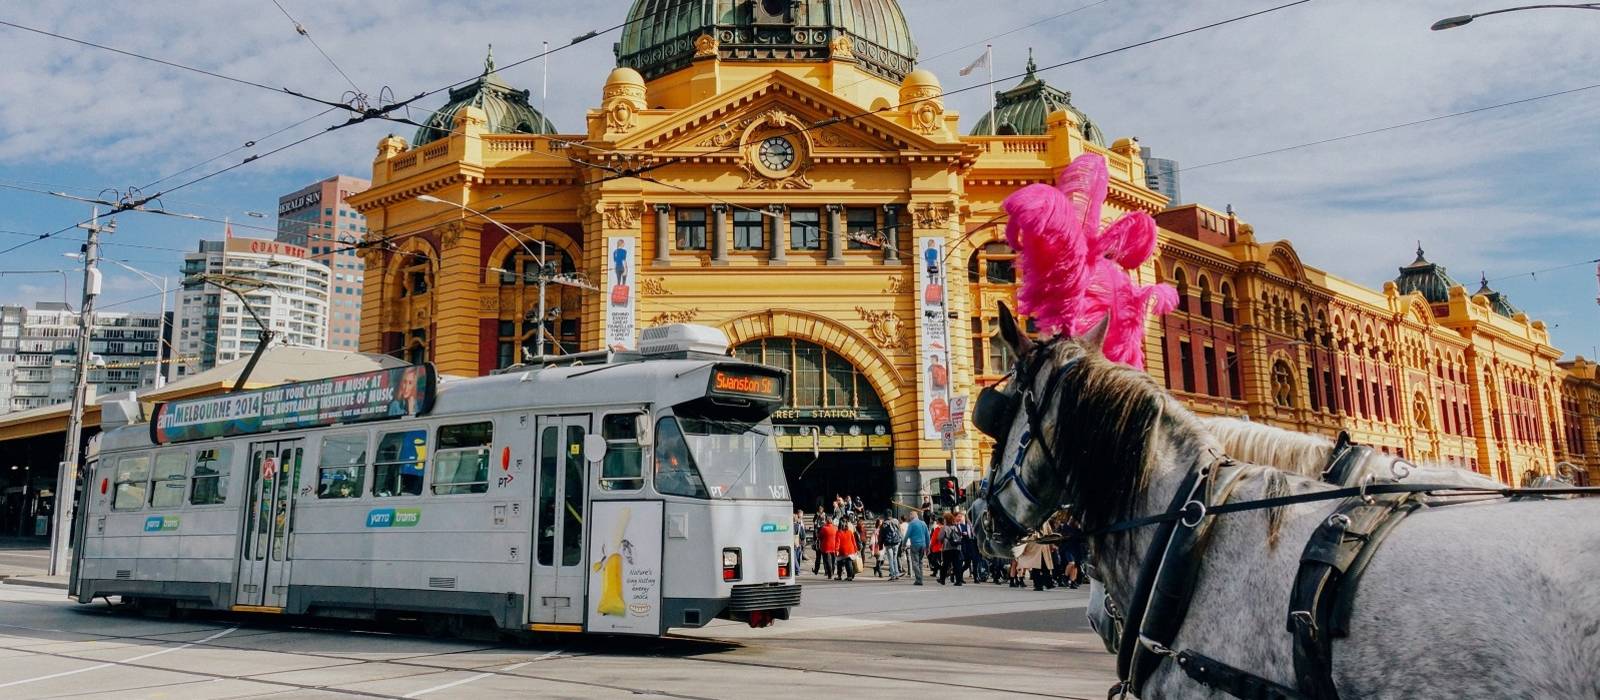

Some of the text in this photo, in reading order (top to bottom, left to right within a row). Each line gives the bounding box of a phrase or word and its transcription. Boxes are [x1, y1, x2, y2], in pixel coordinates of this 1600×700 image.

[305, 192, 320, 205] SUN
[252, 240, 305, 258] QUAY WEST
[264, 375, 382, 403] START YOUR CAREER IN MUSIC AT
[716, 373, 772, 393] Swanston St
[263, 403, 275, 416] THE
[275, 398, 318, 415] AUSTRALIAN
[320, 392, 354, 409] INSTITUTE
[357, 391, 367, 404] OF
[368, 387, 394, 403] MUSIC
[175, 395, 259, 424] MELBOURNE 2014
[771, 409, 857, 419] TREET STATION
[498, 477, 508, 488] PT
[710, 486, 722, 497] PT
[768, 485, 785, 499] 167
[147, 520, 160, 530] yarra
[371, 512, 417, 525] yarra trams
[631, 586, 650, 594] energy
